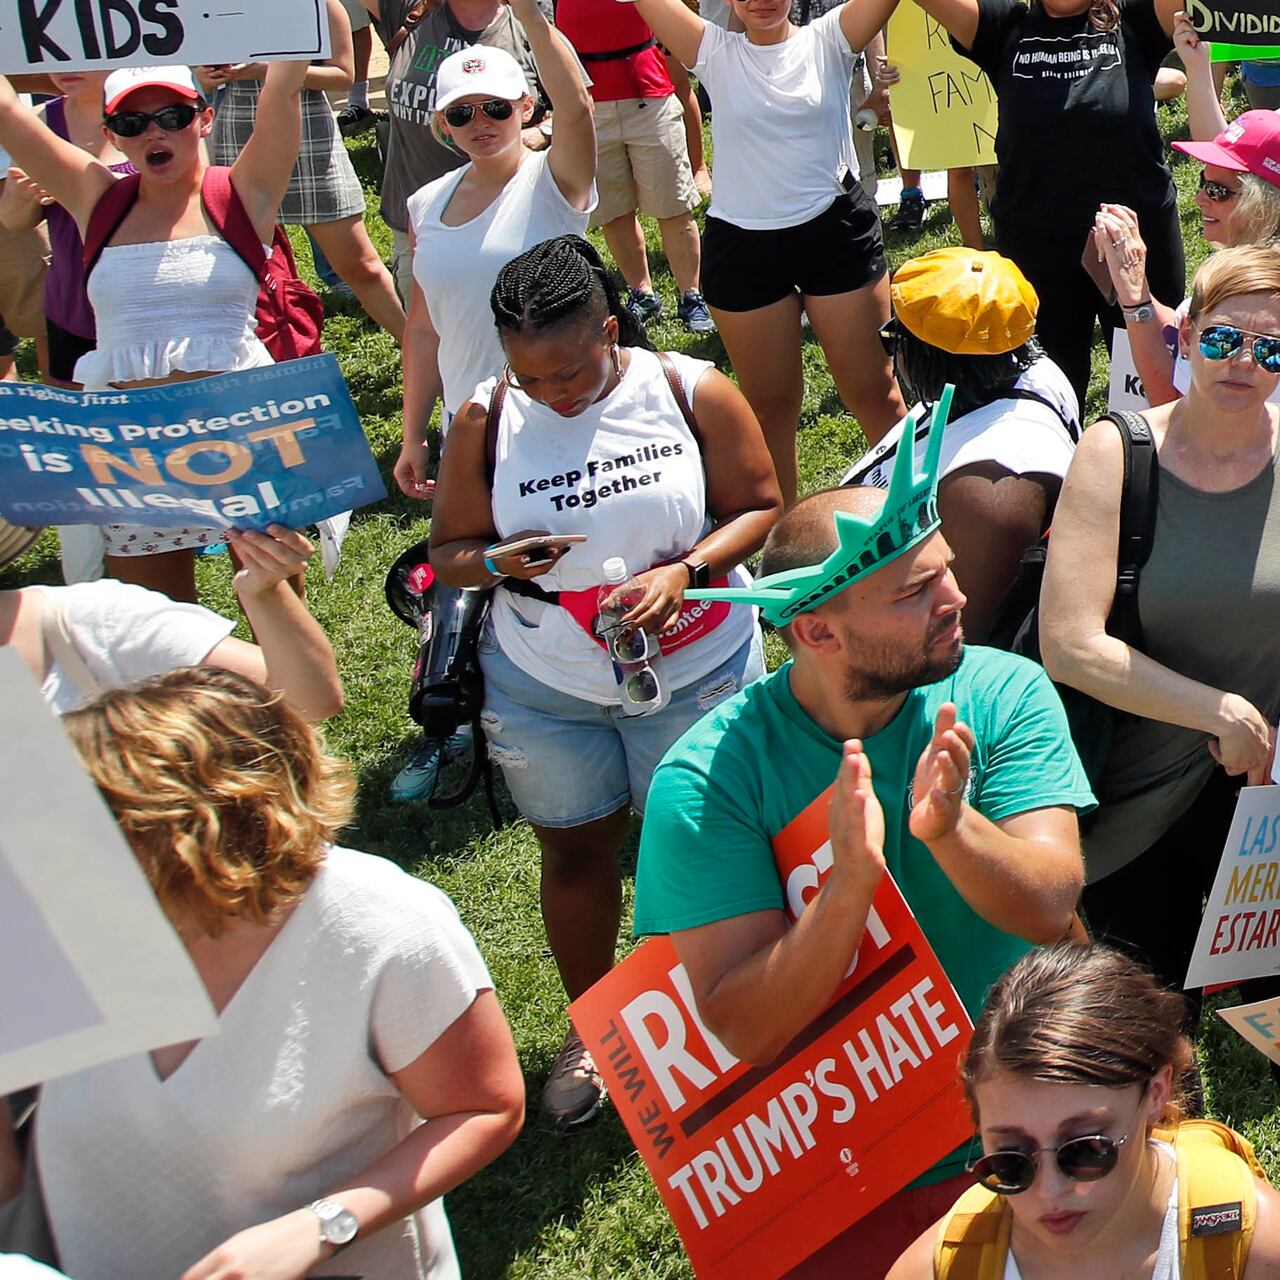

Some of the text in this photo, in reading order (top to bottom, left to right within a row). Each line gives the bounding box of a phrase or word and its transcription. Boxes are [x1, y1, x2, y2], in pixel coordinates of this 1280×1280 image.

[1019, 53, 1030, 64] NO
[1058, 50, 1081, 63] BEING
[118, 392, 331, 442] Protection
[19, 417, 318, 487] is NOT
[519, 441, 684, 497] Keep Families
[550, 469, 663, 513] Together
[598, 1018, 677, 1160] WE WILL
[668, 976, 960, 1230] TRUMP'S HATE
